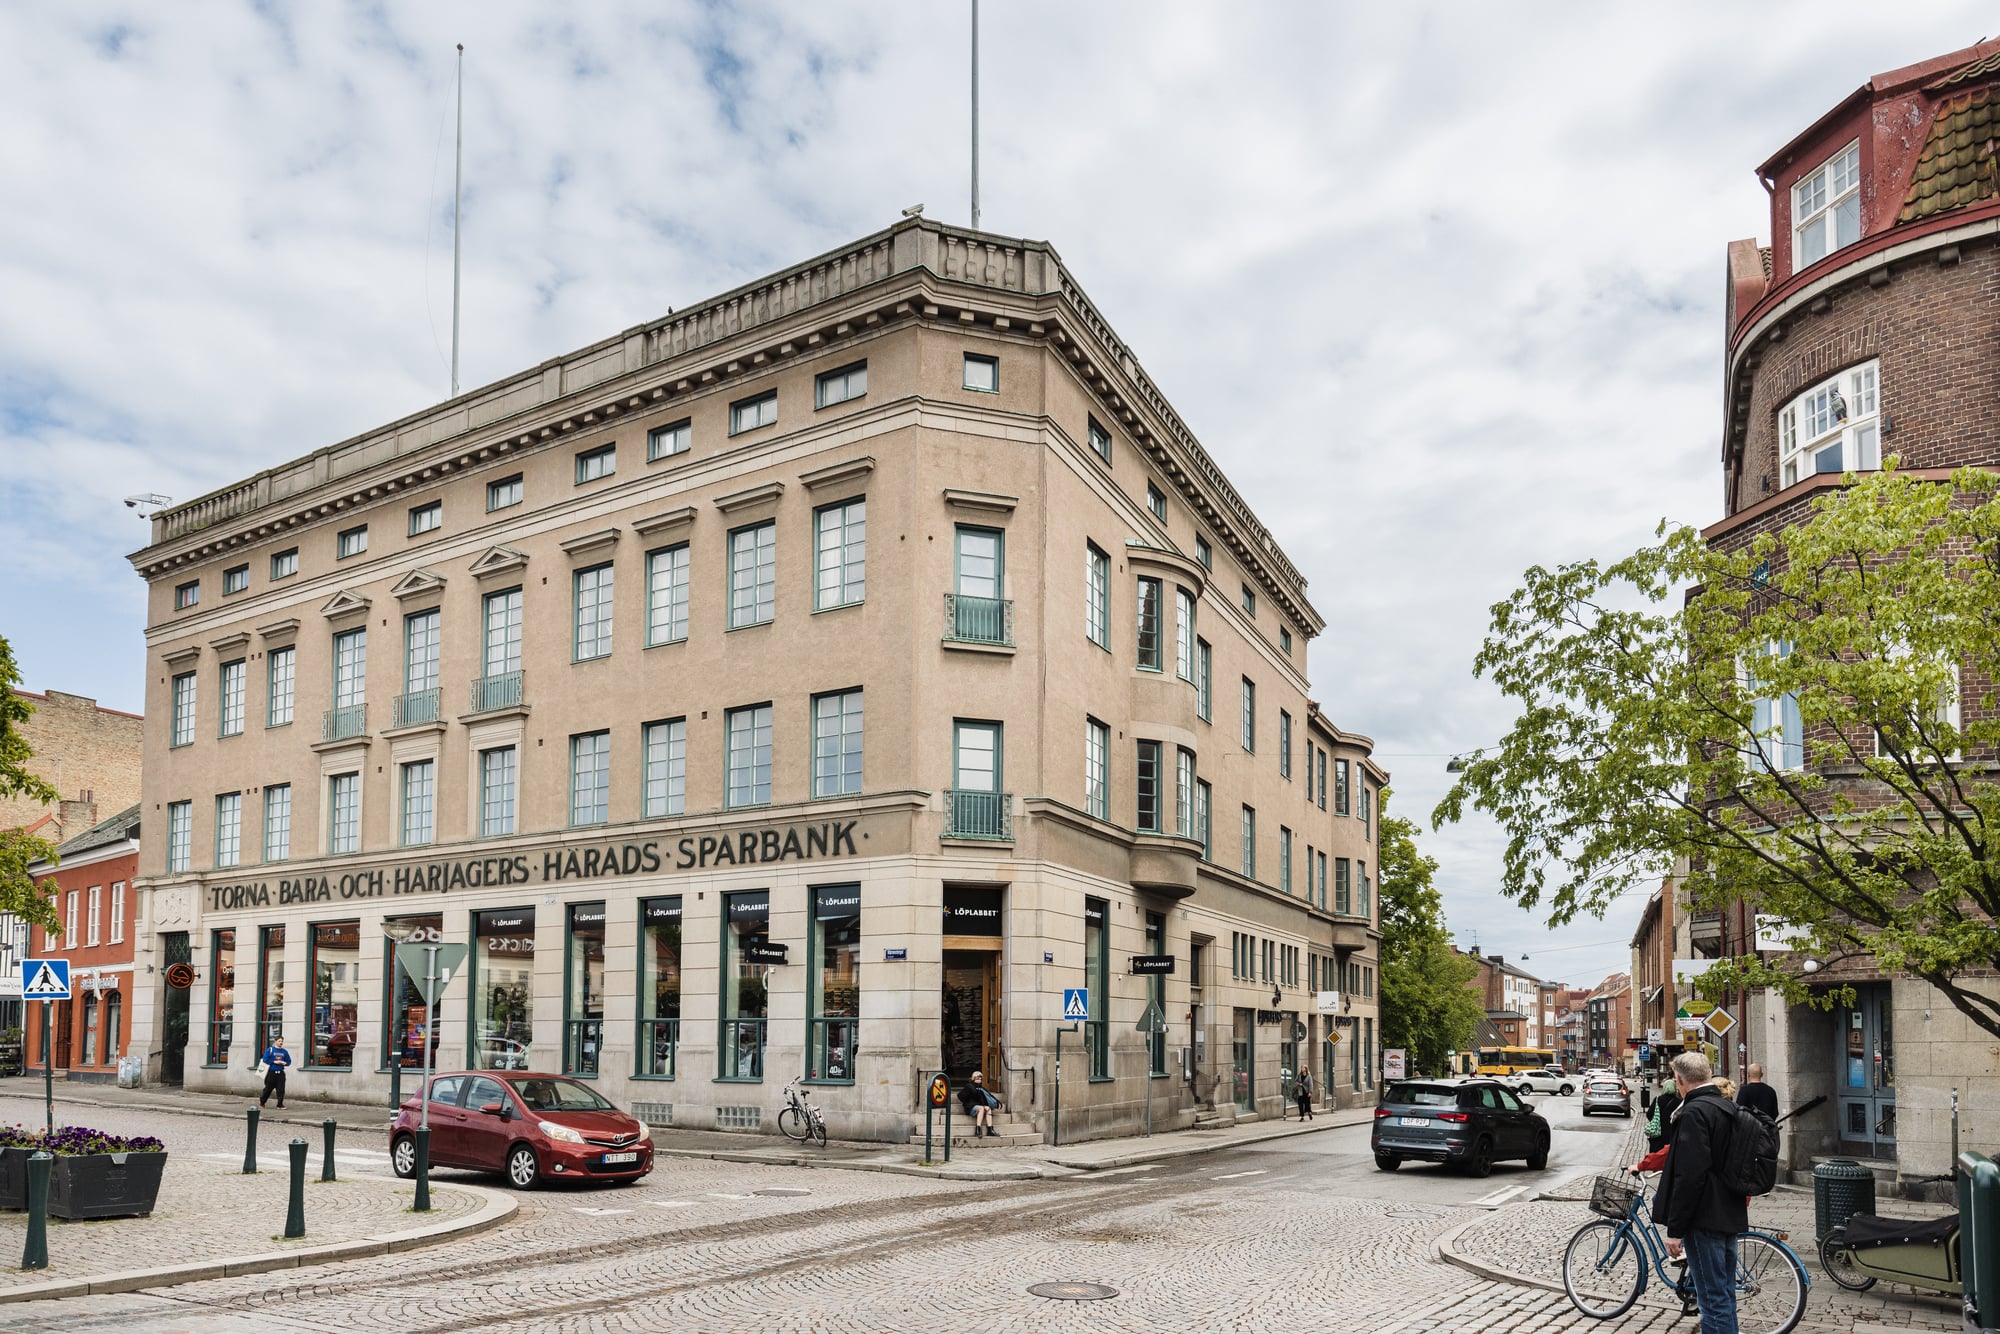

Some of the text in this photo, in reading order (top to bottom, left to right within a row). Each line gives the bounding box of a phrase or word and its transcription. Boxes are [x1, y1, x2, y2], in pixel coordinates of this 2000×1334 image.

[211, 820, 858, 910] TORNA BARA OCH HARJAGERS HÄRADS SPARBANK
[825, 897, 859, 906] LÖPLABBET
[738, 903, 769, 912] LÖPLABBET
[954, 907, 998, 917] LÖPLABBET
[653, 908, 682, 917] LÖPLABBET
[759, 948, 784, 957] LÖPLABBET
